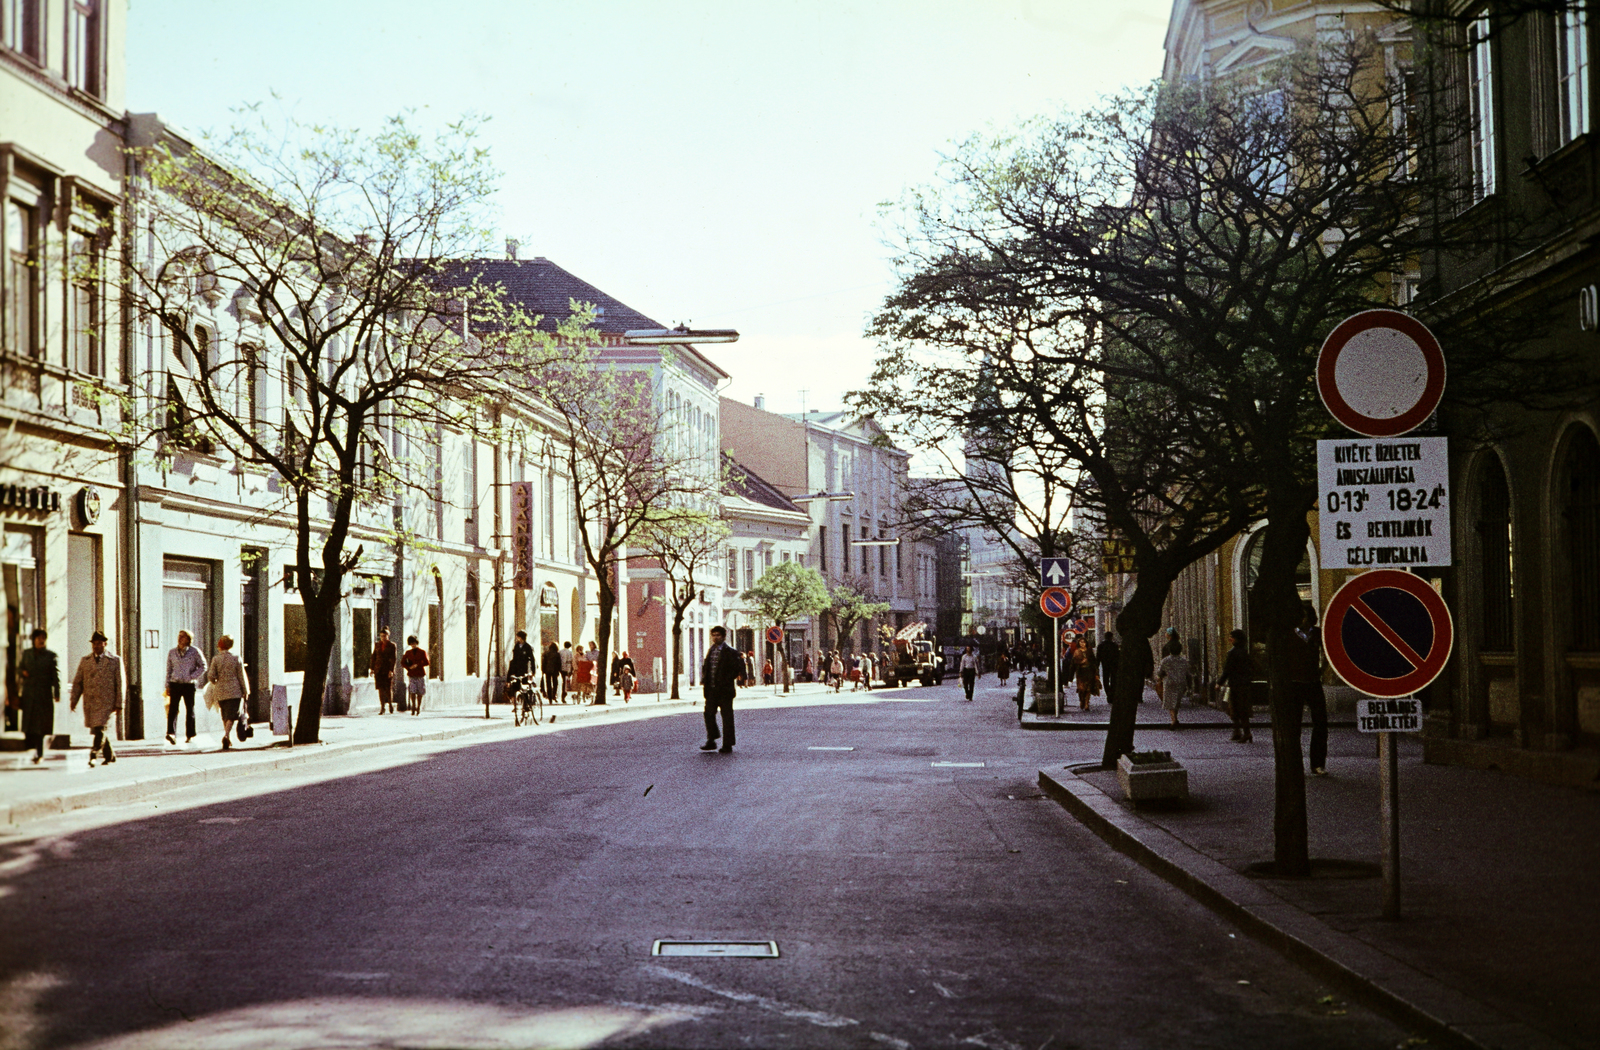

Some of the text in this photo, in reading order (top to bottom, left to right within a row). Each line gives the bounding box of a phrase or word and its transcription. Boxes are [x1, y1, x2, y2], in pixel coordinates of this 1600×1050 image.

[1335, 442, 1371, 464] KIVÉVE
[1336, 517, 1433, 540] ÉS BENTLAKÓK
[1347, 546, 1429, 565] CÉLFORGALMA
